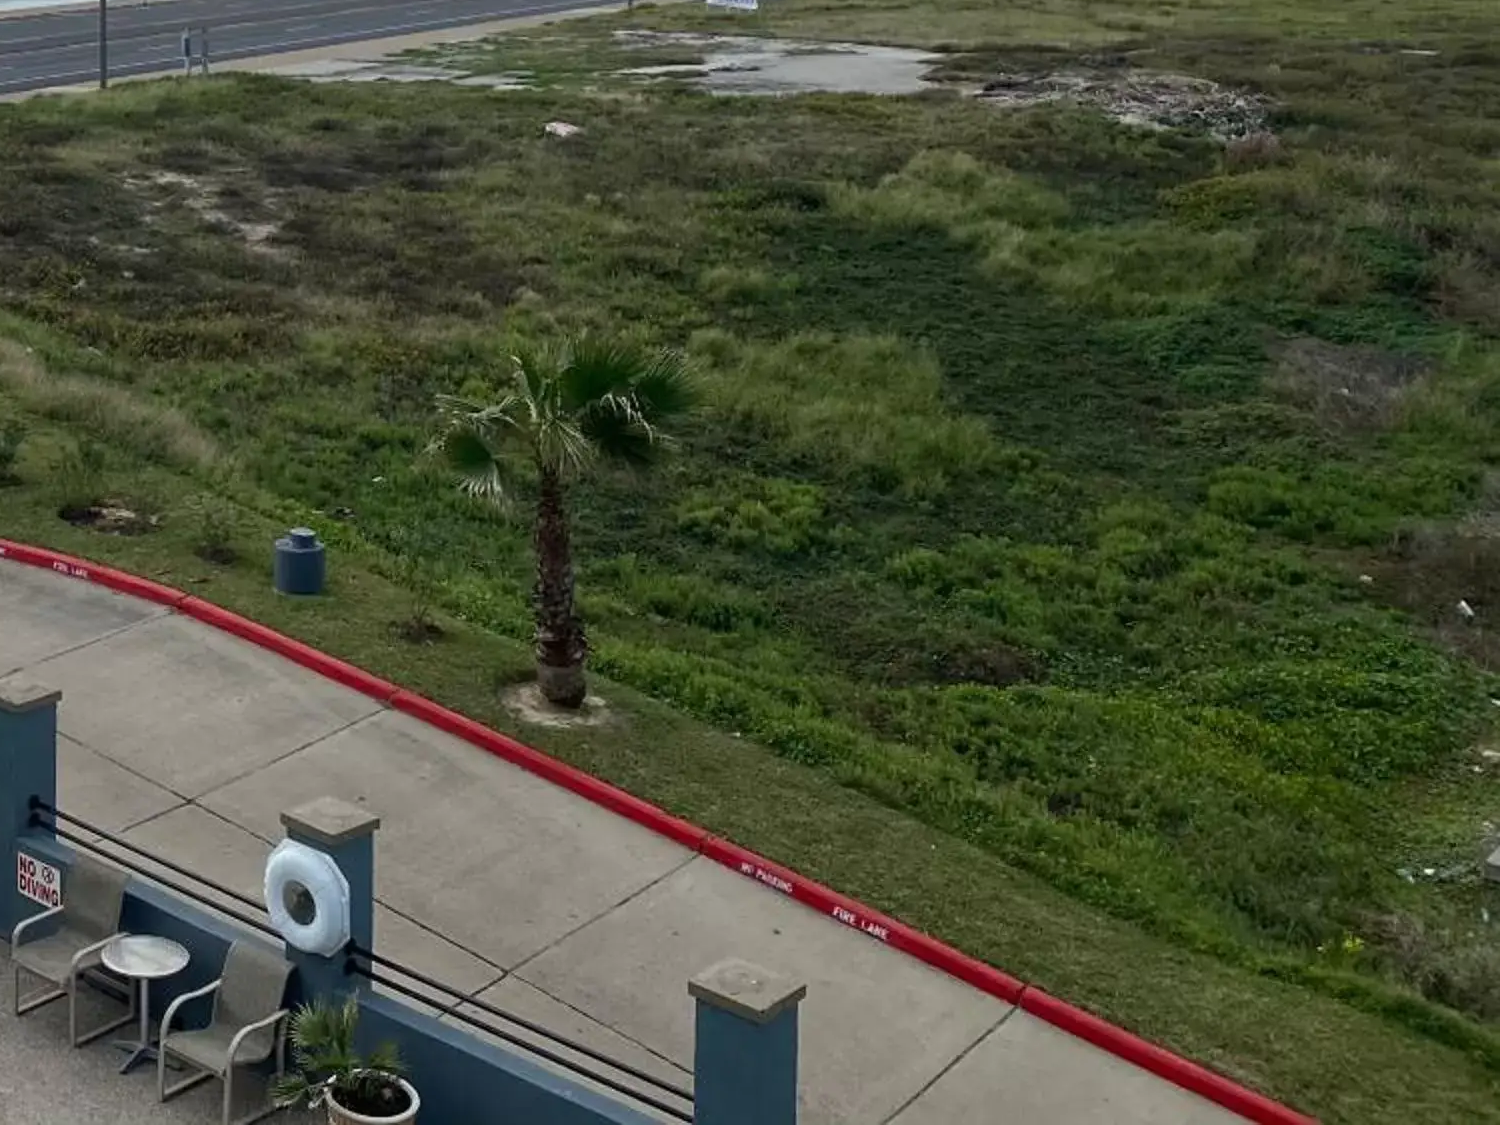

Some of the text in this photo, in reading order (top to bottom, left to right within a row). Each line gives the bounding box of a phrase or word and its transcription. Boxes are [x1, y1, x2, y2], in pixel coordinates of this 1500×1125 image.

[19, 854, 37, 877] NO
[19, 873, 59, 908] DIVING
[831, 905, 890, 941] FIRE LANE
